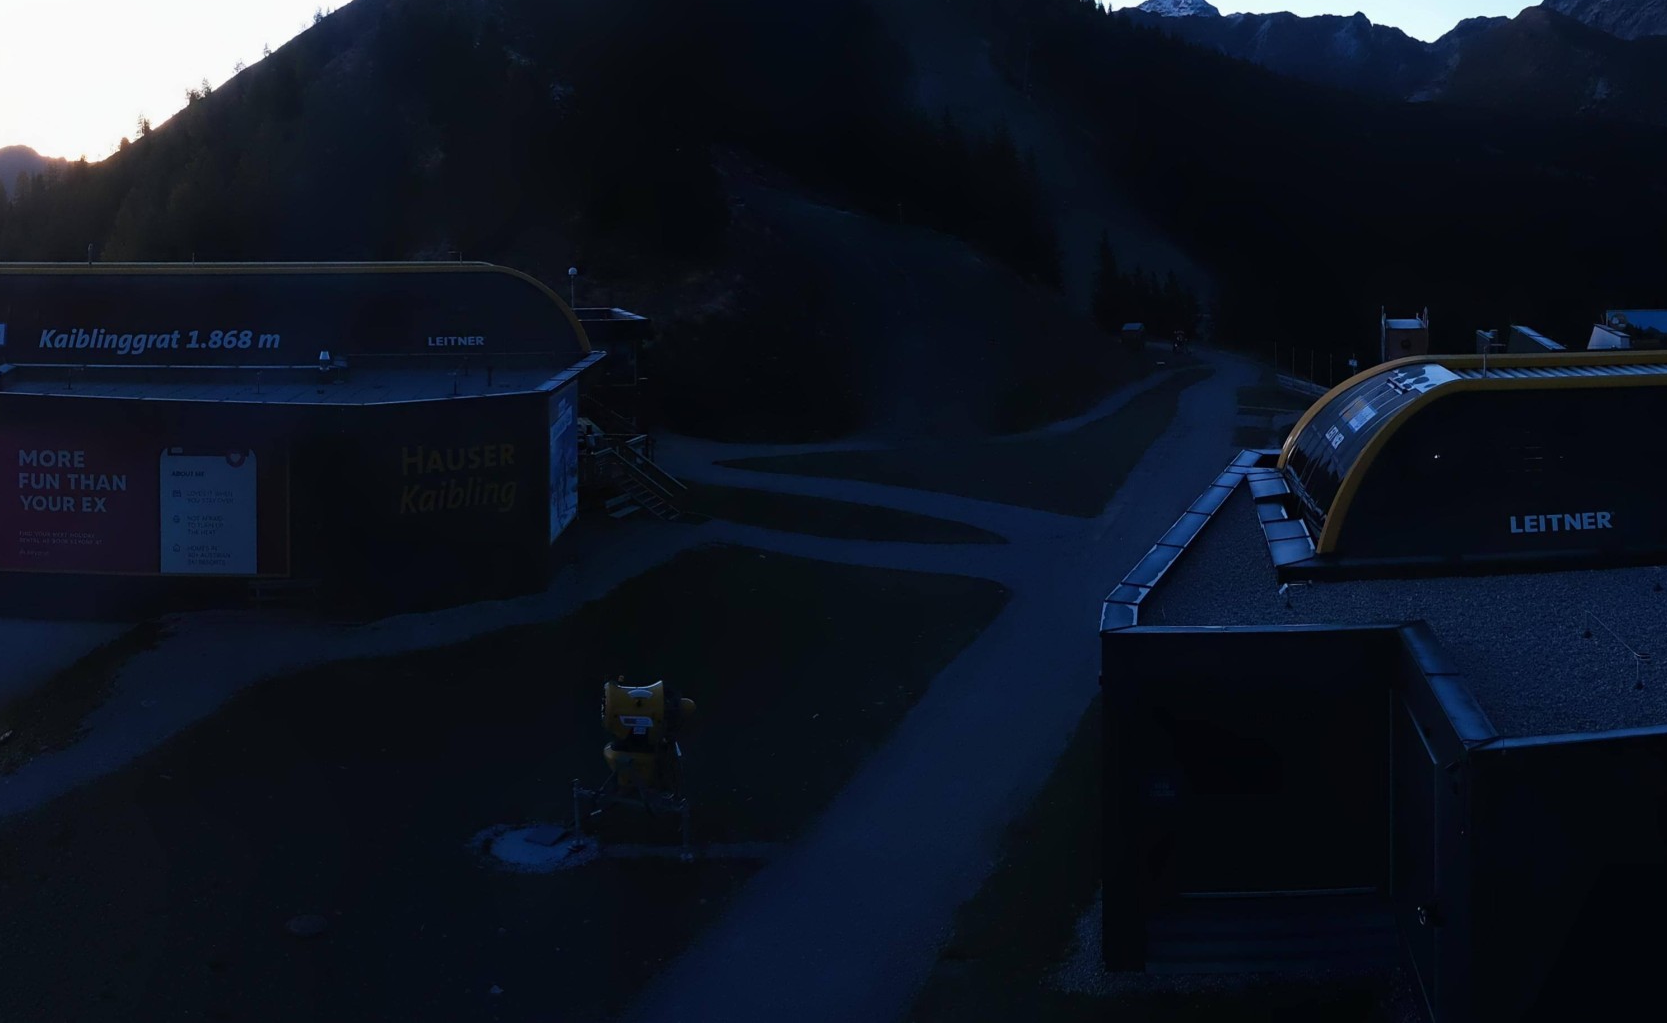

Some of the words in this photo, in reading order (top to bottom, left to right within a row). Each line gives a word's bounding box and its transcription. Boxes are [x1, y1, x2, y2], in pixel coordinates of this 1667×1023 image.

[39, 328, 181, 355] Kaiblinggrat
[186, 330, 252, 349] 1.868
[258, 333, 281, 349] m
[428, 336, 486, 346] LEITNER
[19, 449, 85, 468] MORE
[402, 443, 515, 476] HAUSER
[19, 473, 59, 490] FUN
[67, 474, 127, 491] THAN
[20, 495, 75, 512] YOUR
[81, 497, 107, 512] EX
[401, 477, 517, 514] Kaibling
[1509, 511, 1613, 534] LEITNER
